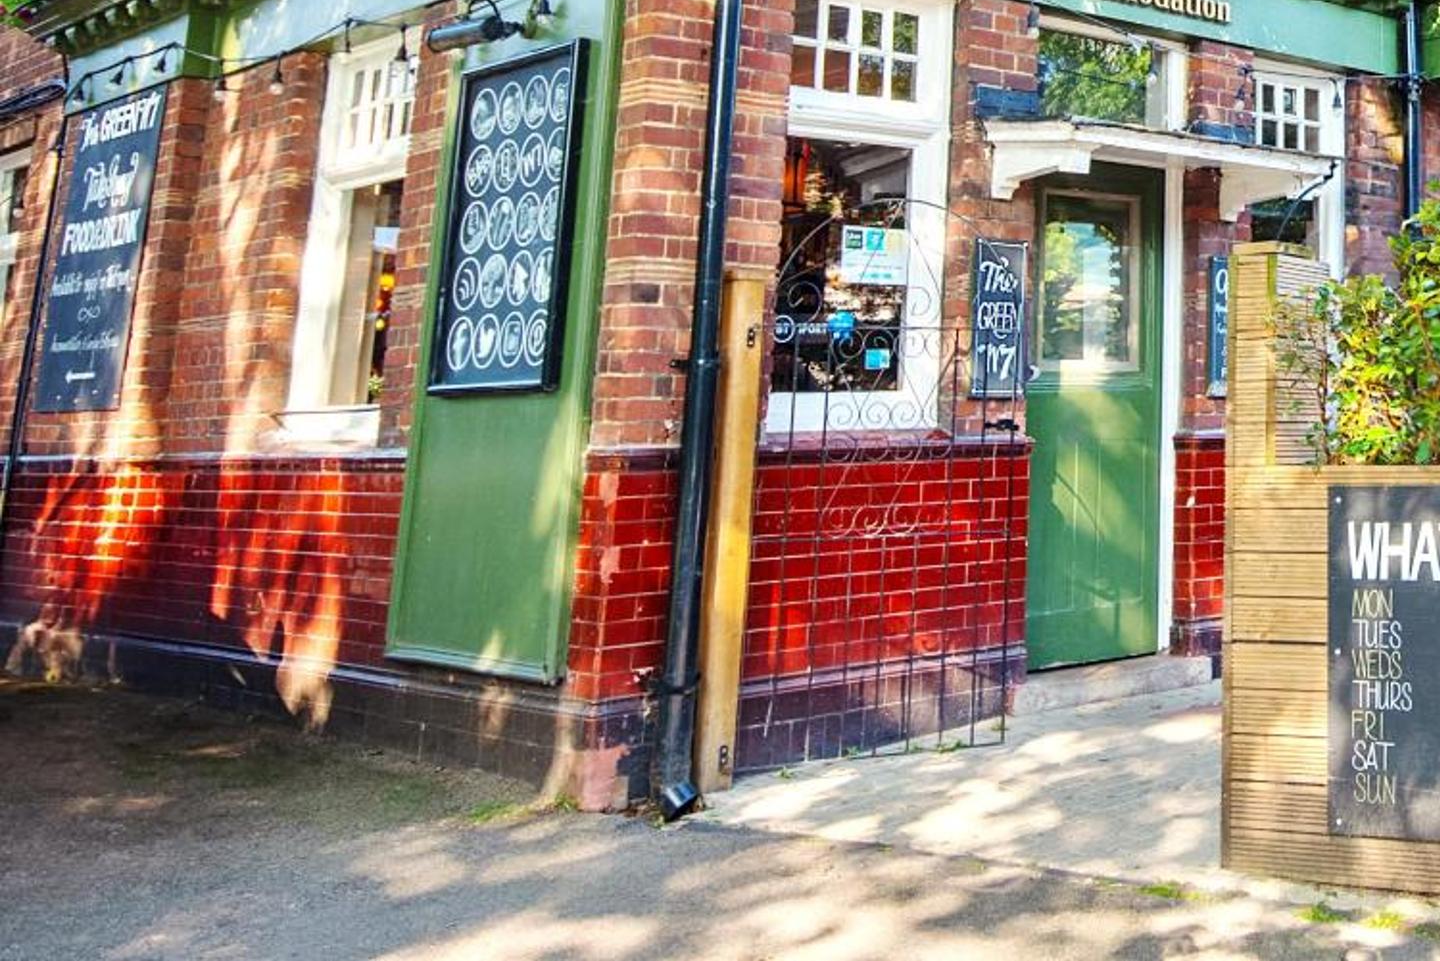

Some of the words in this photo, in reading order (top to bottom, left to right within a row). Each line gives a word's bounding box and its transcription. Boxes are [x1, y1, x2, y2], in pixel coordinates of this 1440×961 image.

[980, 256, 1018, 293] The
[978, 302, 1017, 339] GREEN
[1352, 588, 1393, 618] MON
[1352, 618, 1402, 649] TUES
[1352, 648, 1402, 680] WEDS
[1352, 679, 1413, 711] THURS
[1352, 710, 1384, 741] FRI
[1352, 740, 1395, 771] SAT
[1353, 772, 1397, 805] SUN
